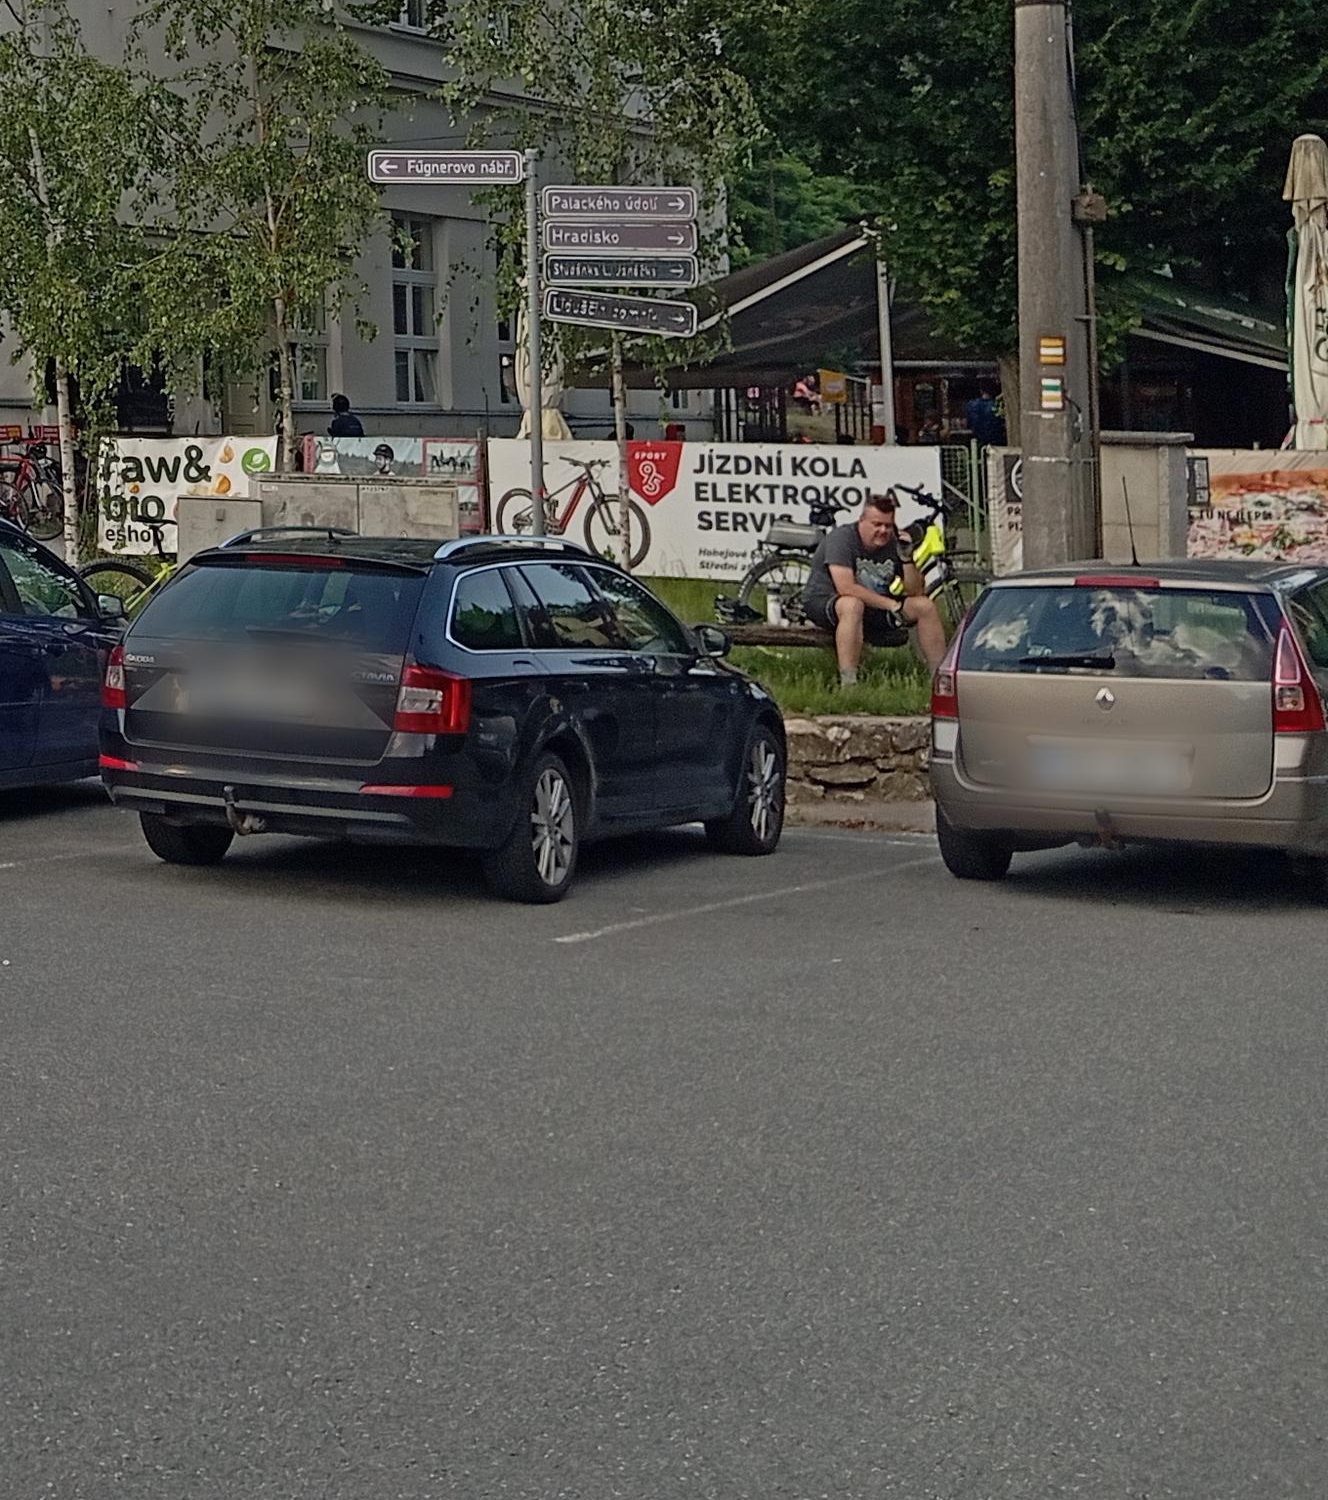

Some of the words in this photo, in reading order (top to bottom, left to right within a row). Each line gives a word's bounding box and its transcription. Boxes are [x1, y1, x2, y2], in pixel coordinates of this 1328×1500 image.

[480, 159, 514, 175] nábř.
[551, 195, 620, 211] Palackého
[625, 196, 659, 211] údolí
[551, 228, 620, 244] Hradisko
[634, 451, 667, 460] SPORT
[103, 444, 212, 484] raw&
[693, 449, 783, 476] JÍZDNÍ
[791, 456, 868, 479] KOLA
[103, 484, 166, 522] bio
[105, 524, 166, 547] eshop
[351, 670, 395, 682] CTAVIA
